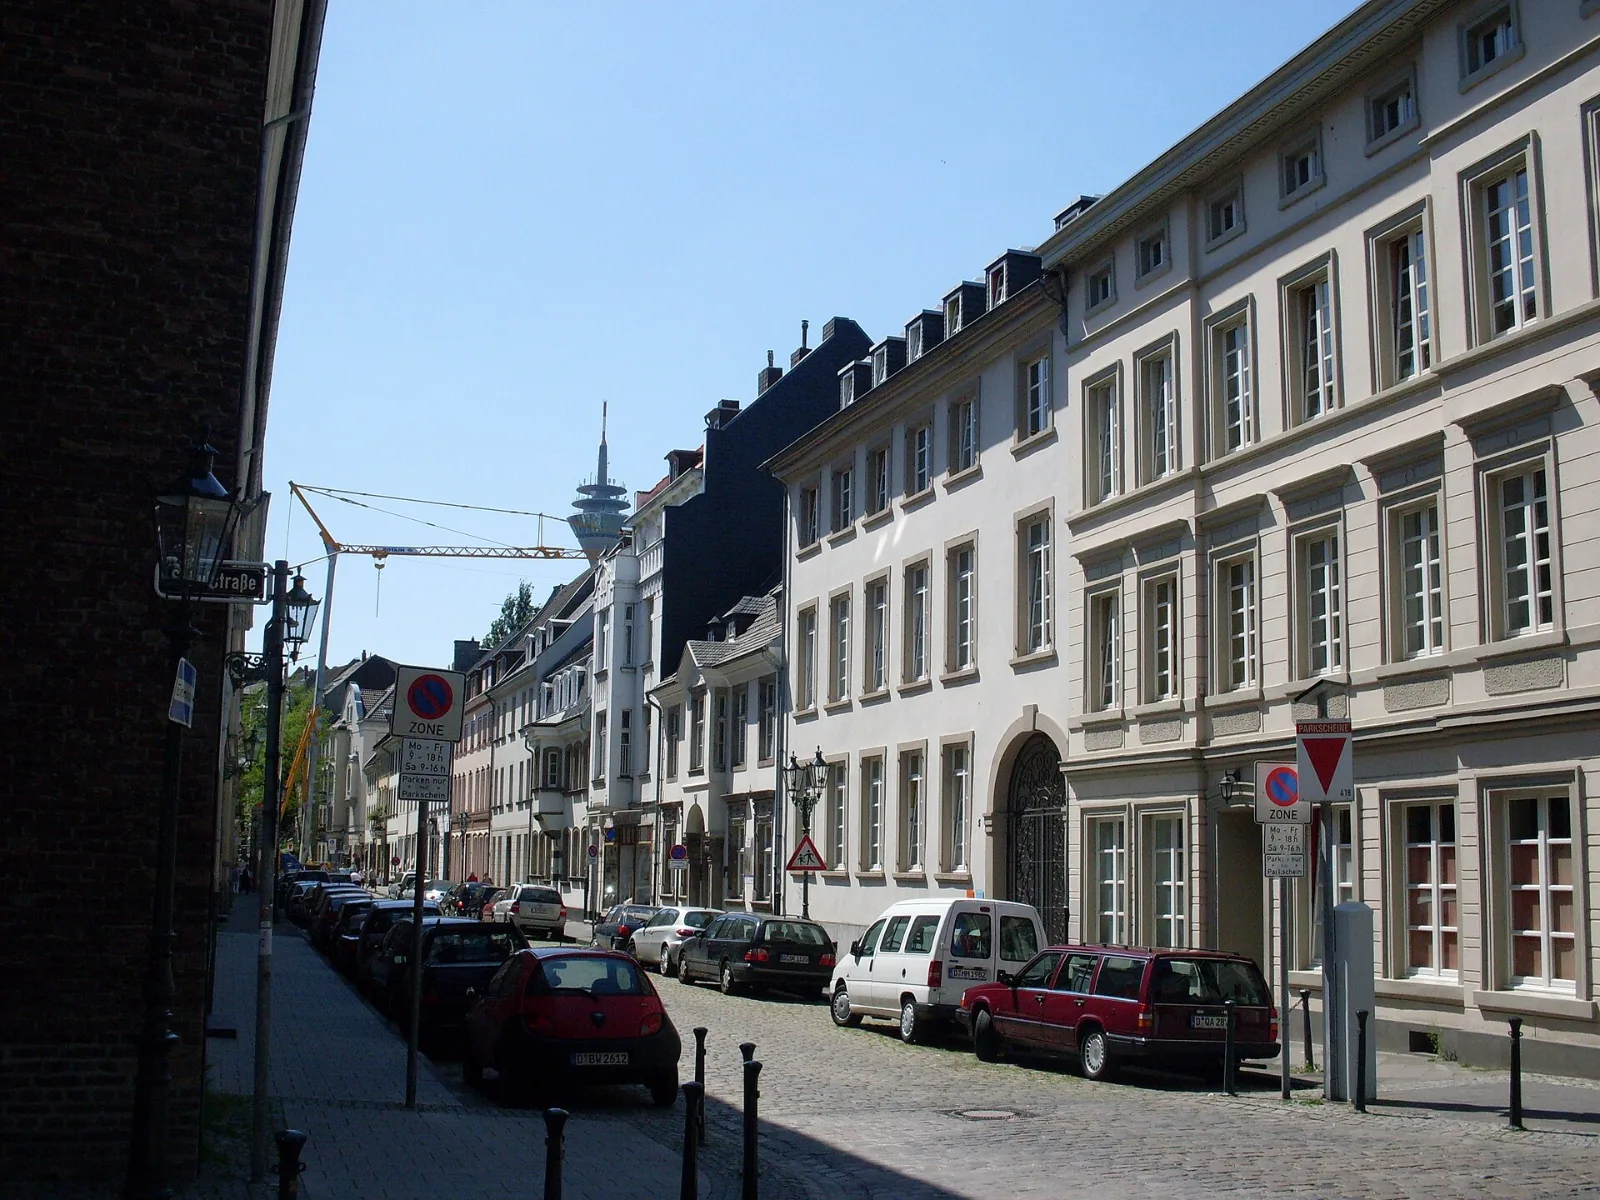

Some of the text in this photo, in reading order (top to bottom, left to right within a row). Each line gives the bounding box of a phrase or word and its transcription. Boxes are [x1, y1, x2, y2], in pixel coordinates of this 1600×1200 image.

[409, 722, 444, 736] ZONE
[1298, 723, 1349, 733] PARKSCHEINE
[409, 742, 421, 750] Mo
[409, 751, 414, 760] 9
[402, 776, 430, 784] Parken
[402, 790, 446, 799] Parkschein
[1270, 810, 1297, 819] ZONE
[604, 1054, 626, 1063] 2612
